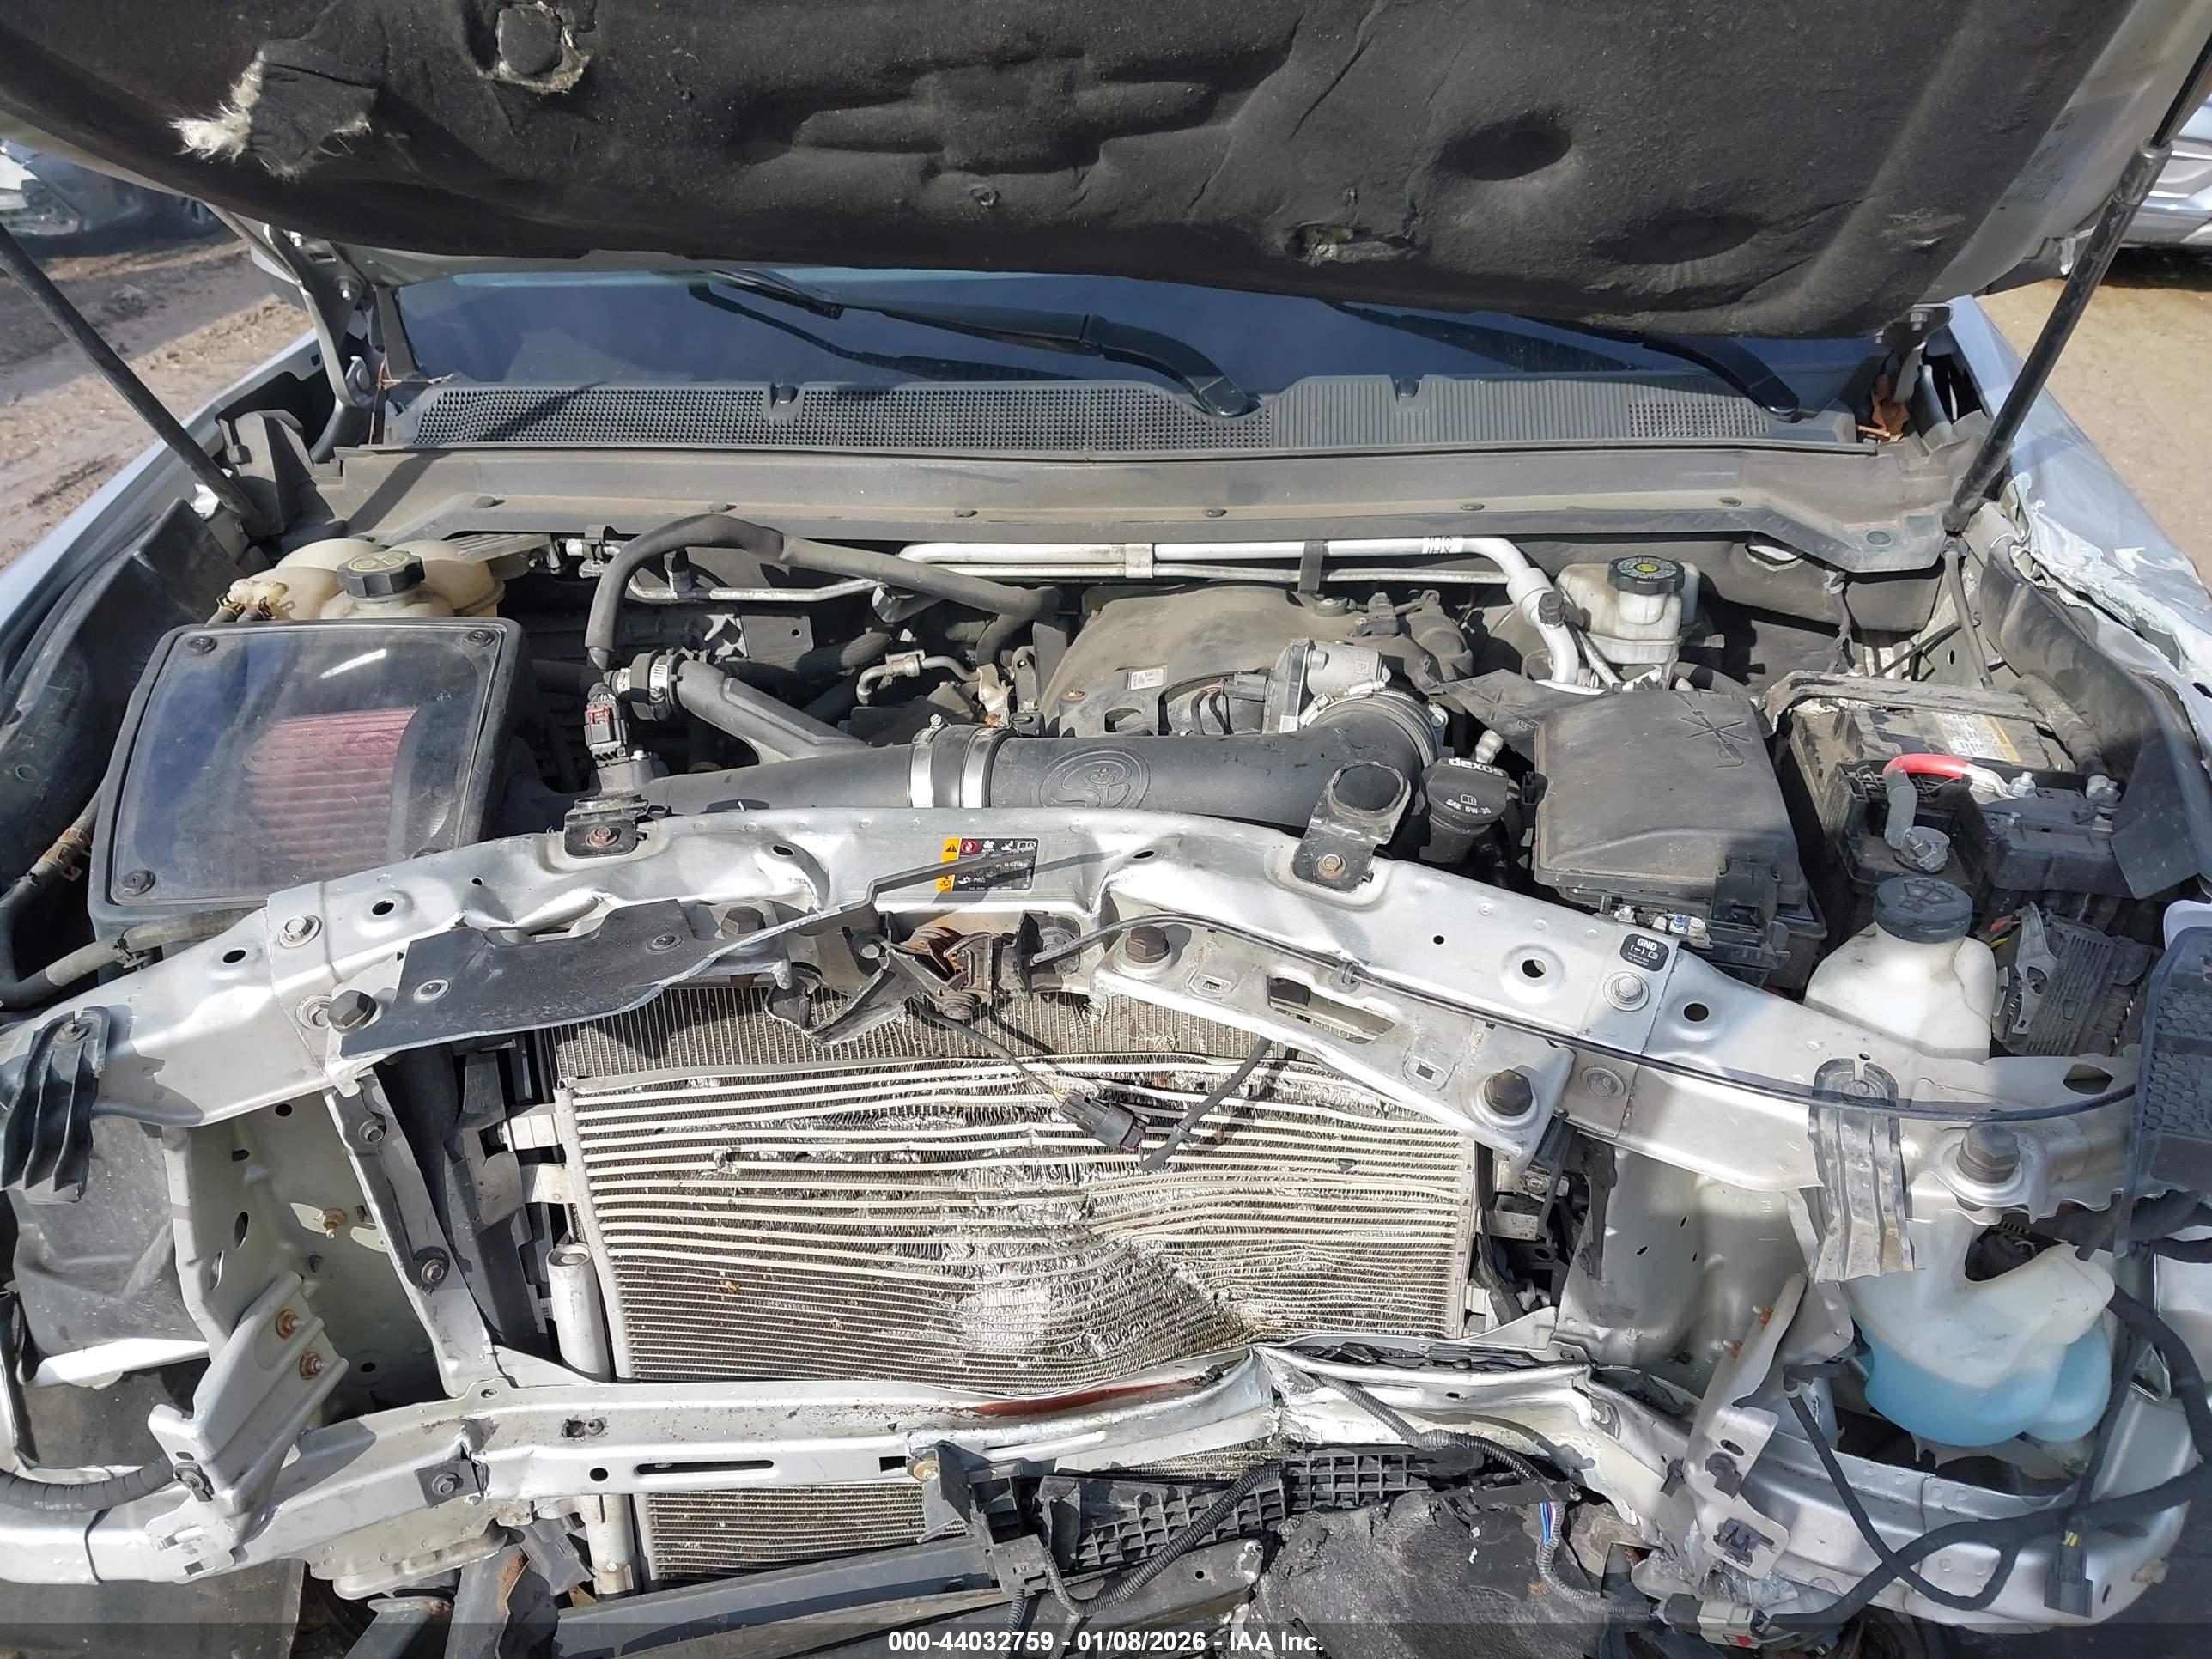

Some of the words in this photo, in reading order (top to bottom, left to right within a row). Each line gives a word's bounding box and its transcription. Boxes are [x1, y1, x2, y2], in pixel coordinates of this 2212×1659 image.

[1449, 757, 1504, 777] dexos
[1445, 799, 1462, 810] SAE
[1637, 938, 1657, 951] GND
